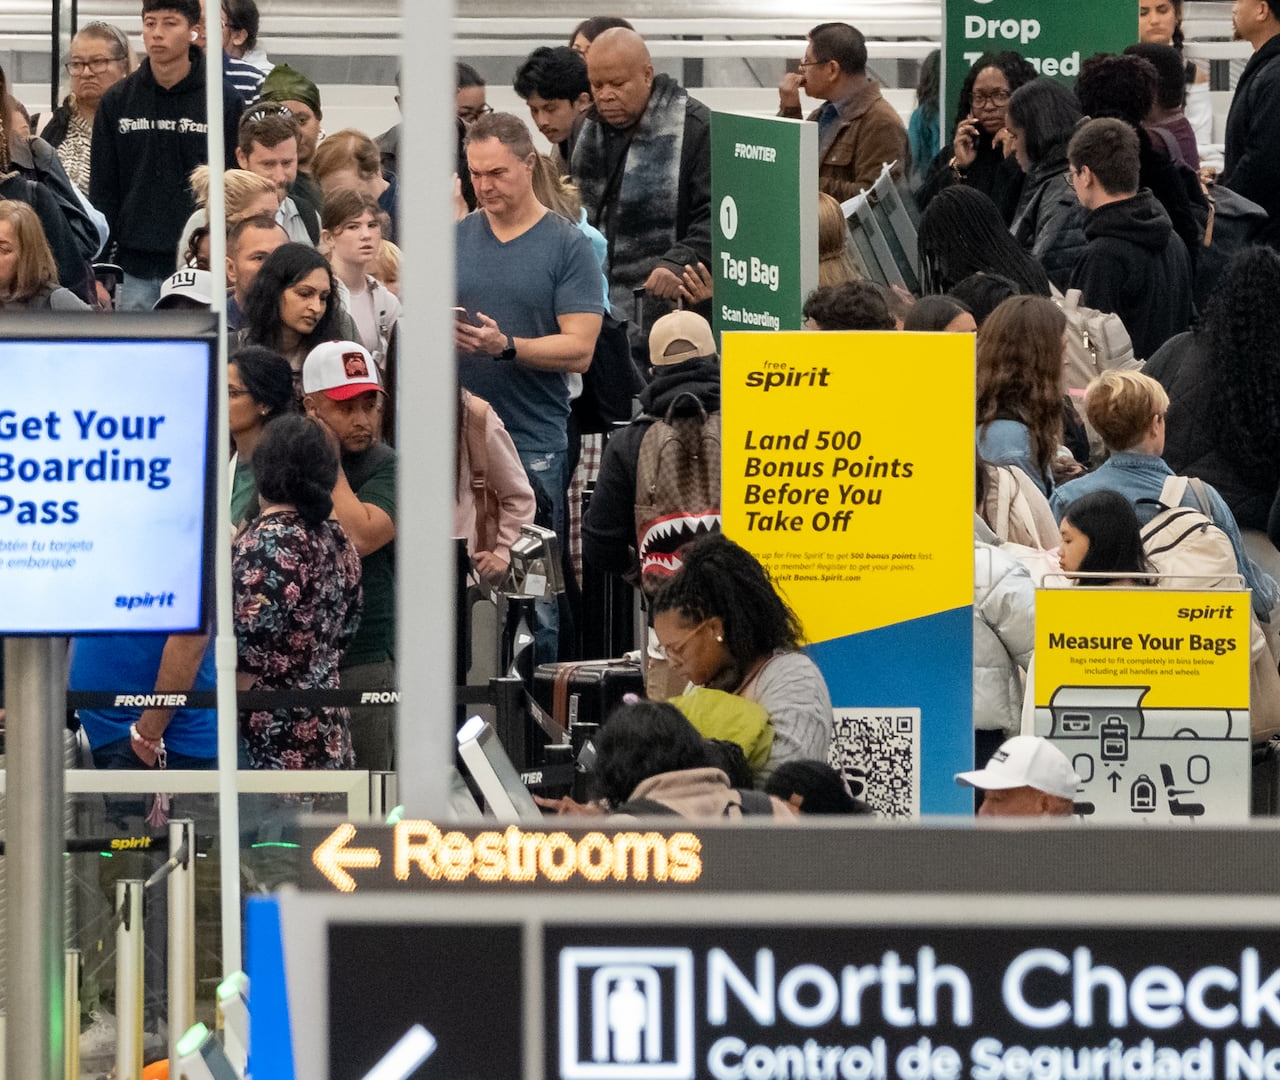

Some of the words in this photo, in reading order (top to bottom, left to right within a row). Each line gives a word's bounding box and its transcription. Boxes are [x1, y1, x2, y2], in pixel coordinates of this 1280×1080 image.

[965, 15, 1041, 44] Drop
[118, 118, 149, 133] Faith
[734, 142, 777, 163] FRONTIER
[725, 206, 731, 230] 1
[721, 251, 747, 287] Tag
[750, 256, 780, 291] Bag
[722, 305, 742, 323] Scan
[742, 307, 780, 331] boarding
[763, 360, 787, 370] free
[745, 367, 830, 392] spirit
[73, 410, 166, 441] Your
[744, 429, 809, 450] Land
[815, 430, 862, 451] 500
[744, 457, 825, 478] Bonus
[832, 455, 914, 478] Points
[744, 482, 830, 505] Before
[839, 484, 882, 505] You
[745, 510, 804, 531] Take
[812, 510, 854, 532] Off
[31, 538, 46, 553] tu
[48, 538, 94, 555] tarjeta
[866, 552, 889, 560] bonus
[891, 552, 916, 561] points
[6, 555, 76, 570] embarque
[817, 563, 847, 572] Register
[114, 592, 174, 610] spirit
[1177, 605, 1234, 621] spirit
[1049, 632, 1133, 650] Measure
[1138, 634, 1184, 651] Your
[1189, 634, 1237, 655] Bags
[1070, 657, 1087, 665] Bags
[1126, 658, 1166, 666] completely
[1084, 668, 1118, 676] including
[1175, 668, 1200, 676] wheels
[114, 694, 187, 708] FRONTIER
[361, 692, 401, 704] FRON
[111, 835, 154, 851] spirit
[392, 826, 703, 884] Restrooms
[707, 947, 973, 1028] North
[708, 1039, 886, 1080] Control
[897, 1038, 962, 1080] de
[972, 1038, 1214, 1080] Seguridad
